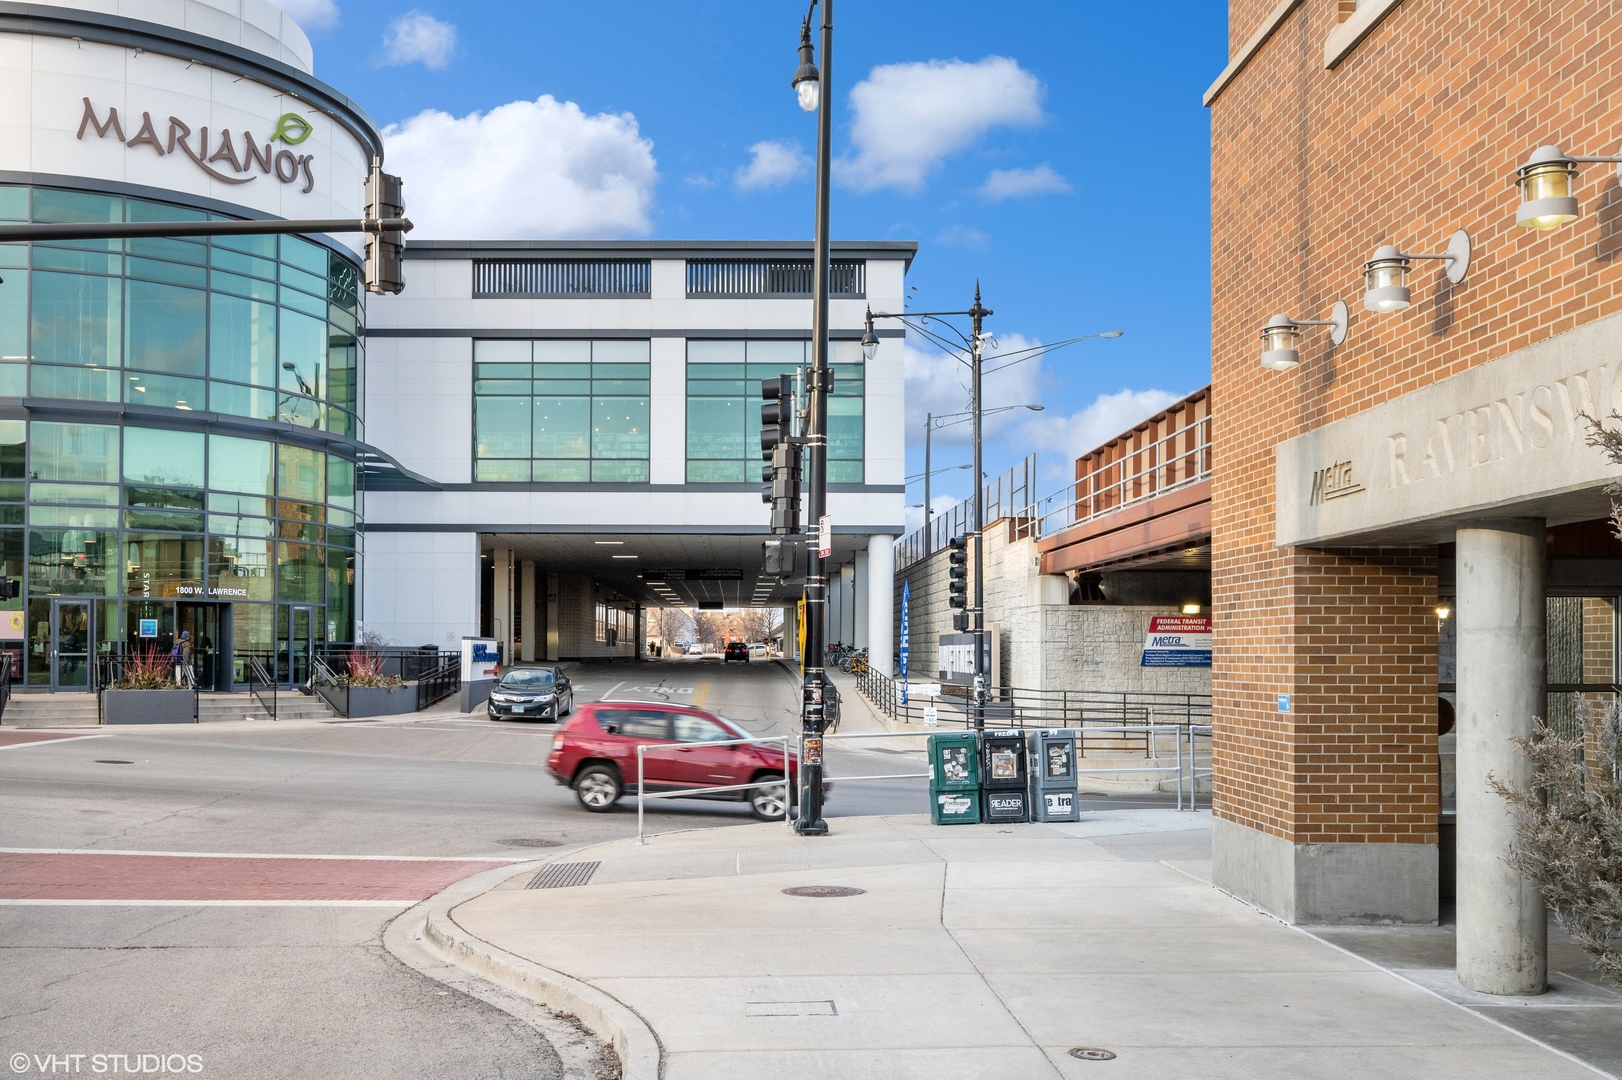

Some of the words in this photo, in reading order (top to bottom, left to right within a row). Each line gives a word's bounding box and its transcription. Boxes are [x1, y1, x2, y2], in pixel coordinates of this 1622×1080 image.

[76, 96, 315, 194] MARIANO'S
[1309, 460, 1354, 507] Metra
[208, 588, 247, 596] LAWRENCE
[1152, 636, 1181, 647] Metra
